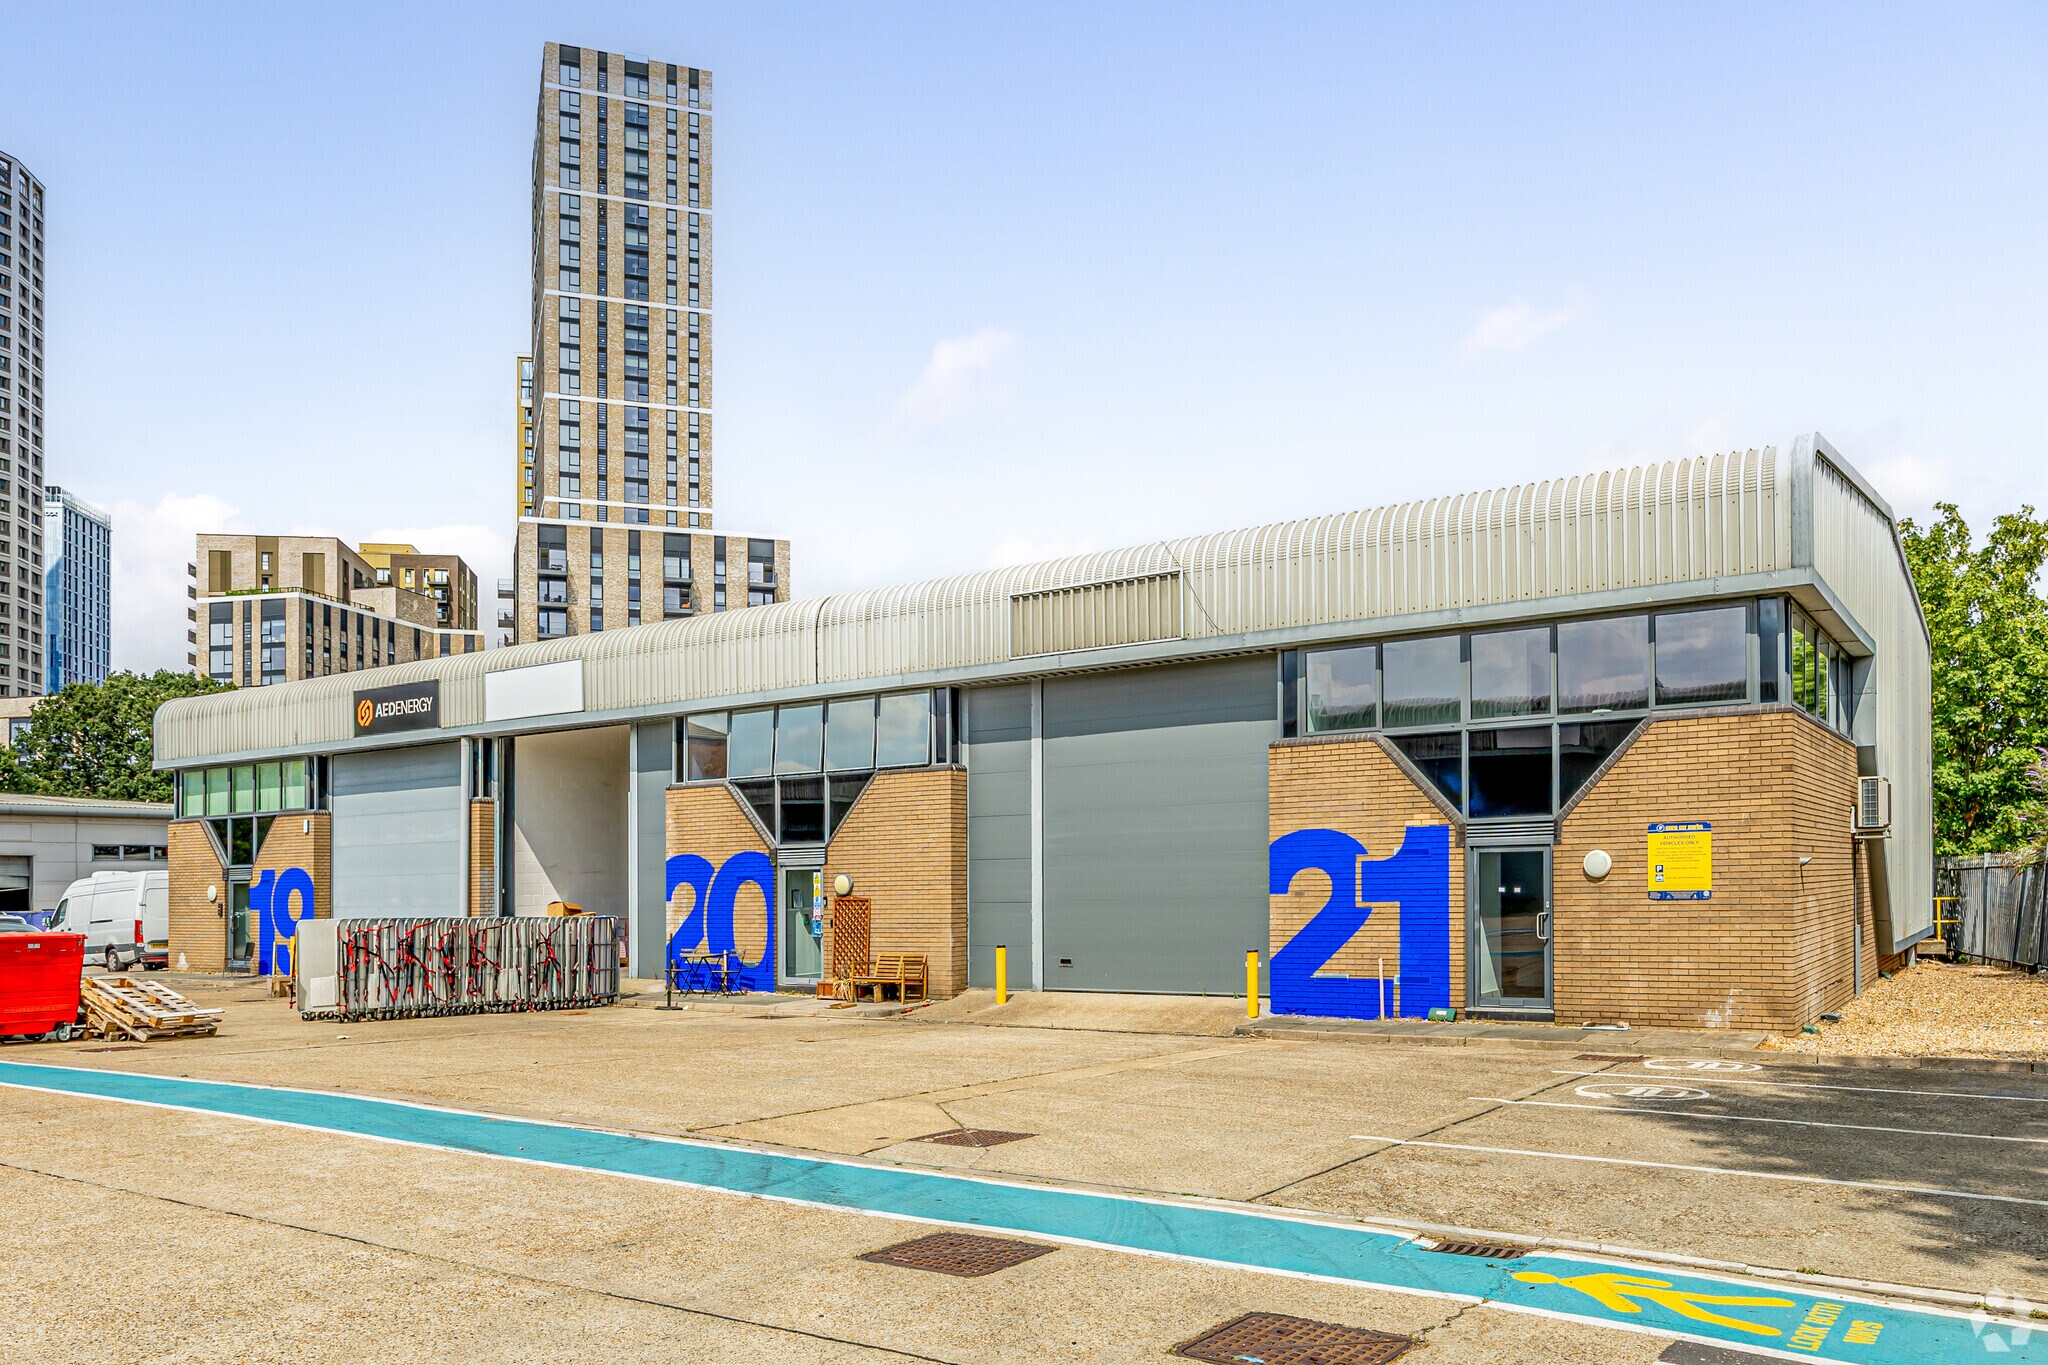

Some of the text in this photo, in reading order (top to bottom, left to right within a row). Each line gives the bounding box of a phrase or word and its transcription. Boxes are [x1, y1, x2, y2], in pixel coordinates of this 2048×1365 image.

[375, 696, 433, 718] AEDENERGY
[250, 867, 315, 977] 19
[666, 851, 775, 993] 20
[1269, 825, 1450, 1020] 21
[1786, 1301, 1845, 1352] LOOK BOTH
[1842, 1320, 1884, 1345] WAYS
